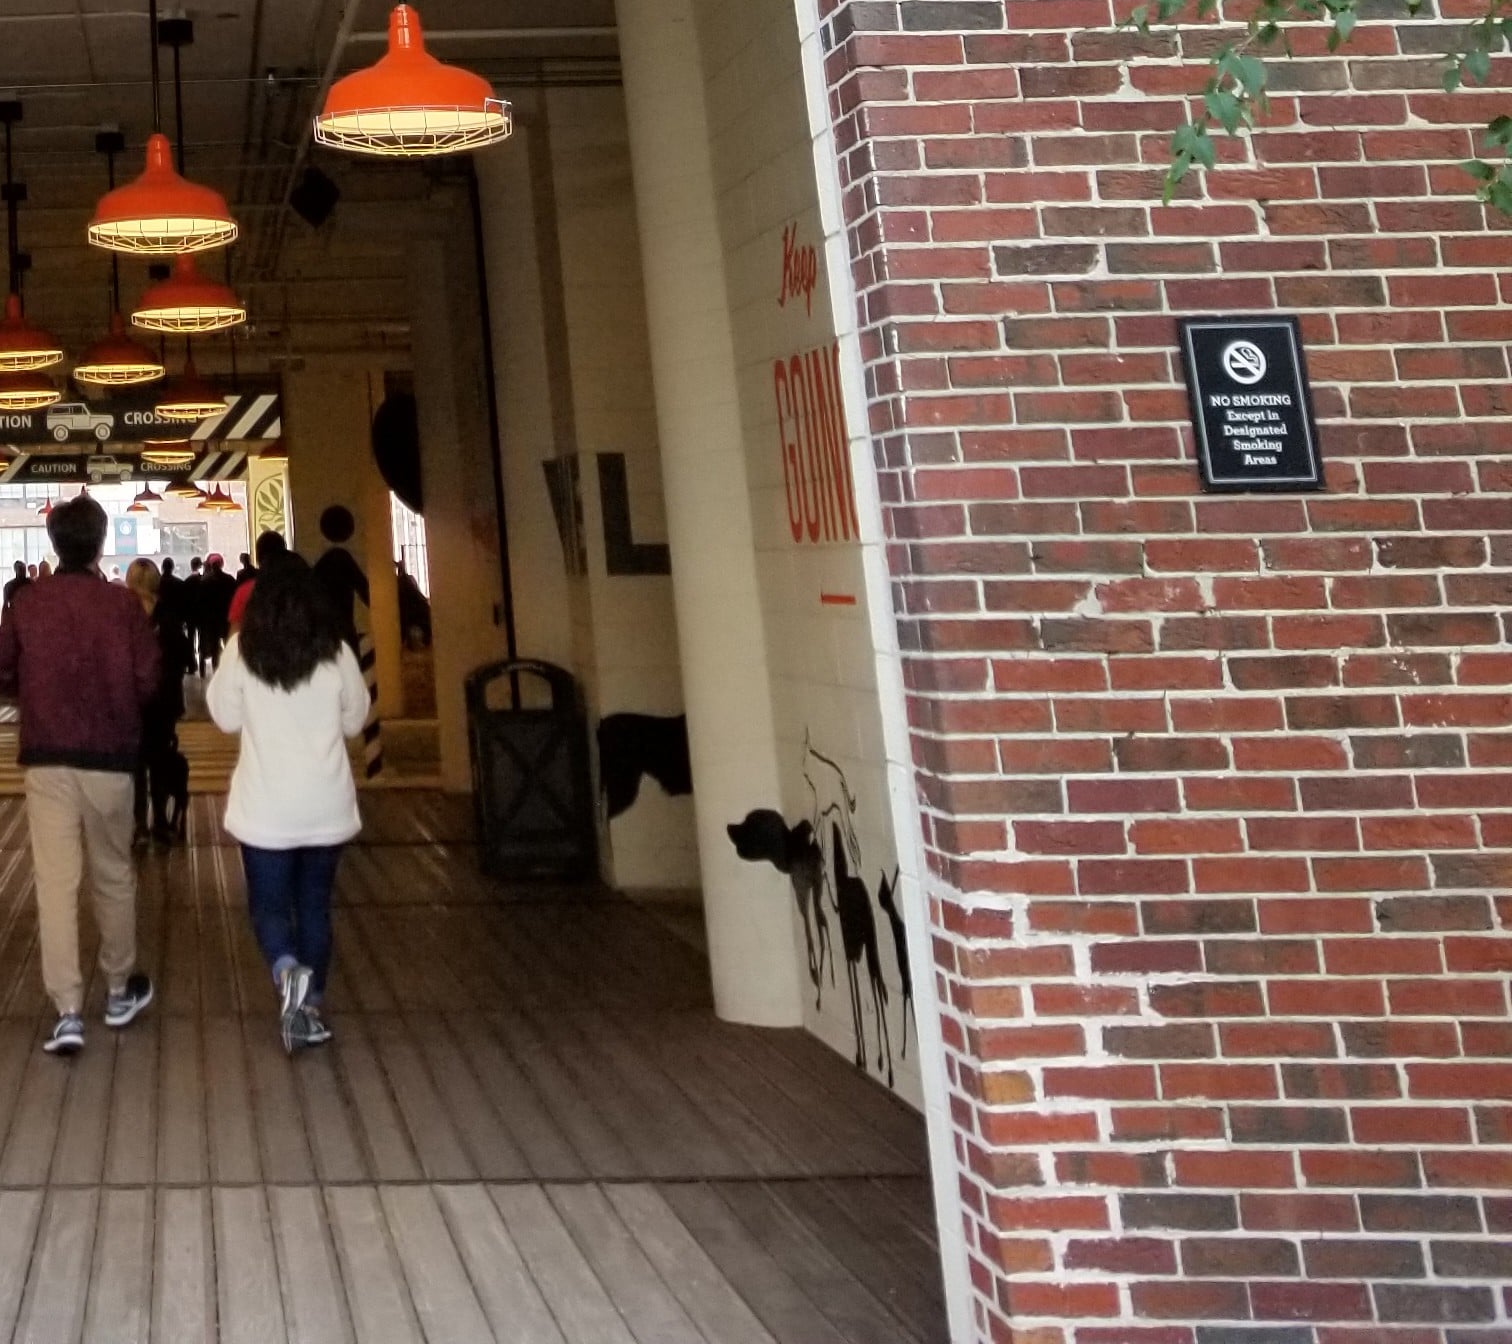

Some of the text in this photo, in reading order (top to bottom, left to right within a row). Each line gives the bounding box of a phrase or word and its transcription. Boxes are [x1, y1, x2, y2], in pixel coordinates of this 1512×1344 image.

[1210, 394, 1292, 407] NO SMOKING
[1227, 410, 1280, 423] Except in
[1224, 423, 1288, 438] Designated
[1233, 439, 1283, 452] Smoking
[1244, 454, 1277, 465] Areas
[31, 462, 192, 473] CAUTION CROSSING
